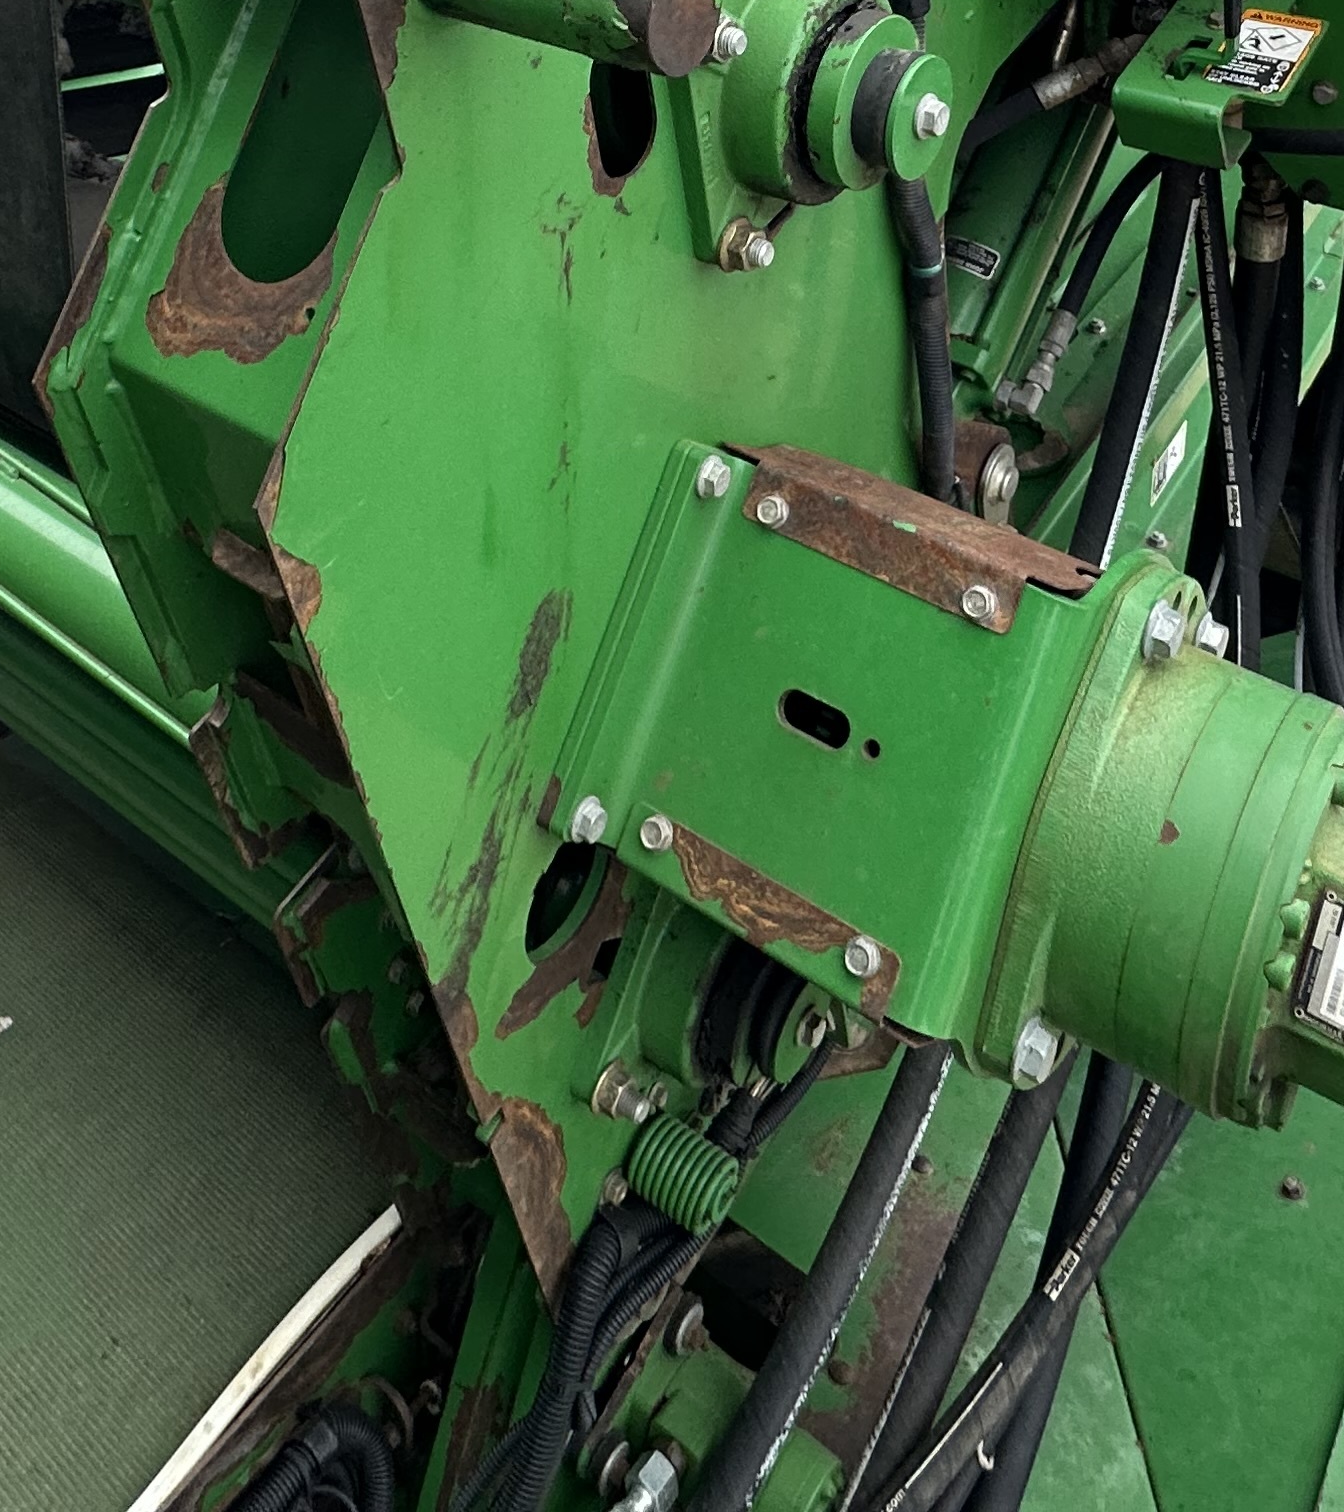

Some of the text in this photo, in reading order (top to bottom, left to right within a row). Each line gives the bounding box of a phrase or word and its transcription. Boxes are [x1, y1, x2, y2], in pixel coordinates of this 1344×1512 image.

[1265, 14, 1319, 29] WARNING
[1228, 486, 1240, 521] Parker
[1049, 1256, 1076, 1293] Parker
[1110, 1137, 1139, 1187] 471TC-12
[1141, 1096, 1157, 1119] 21.5
